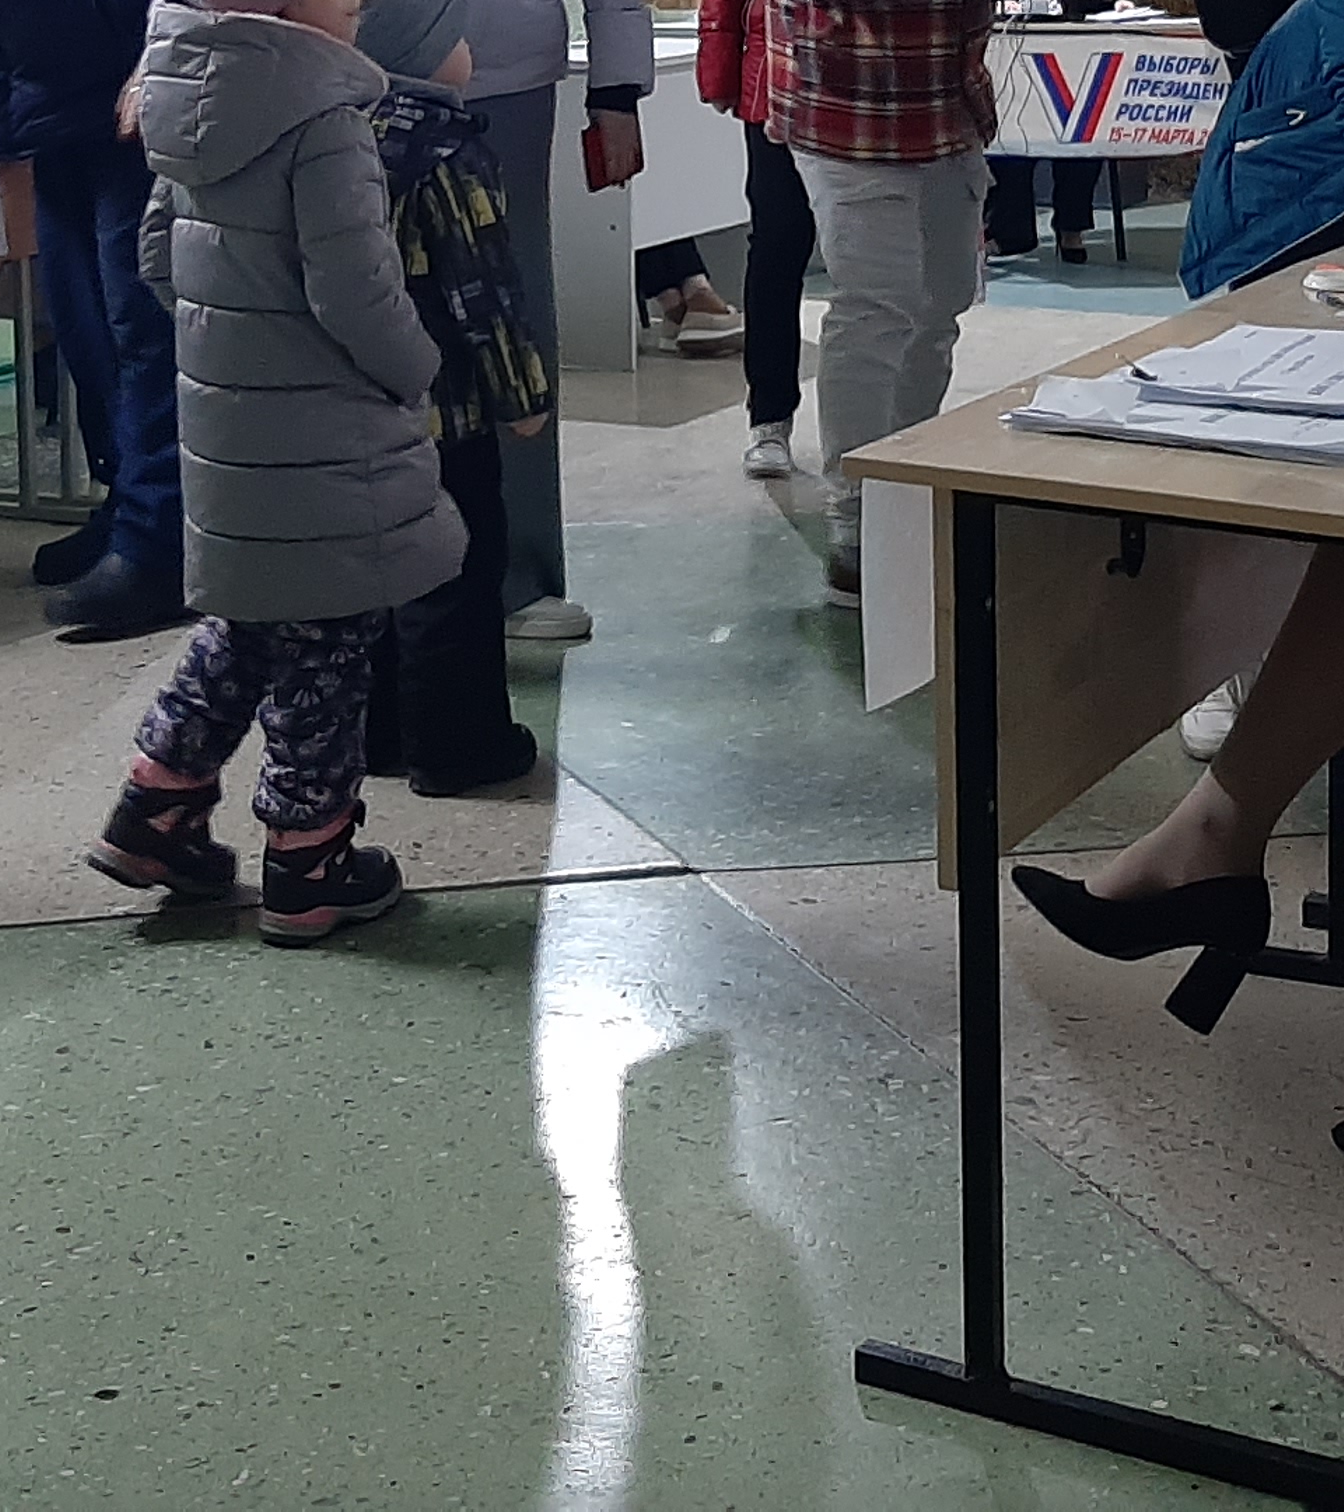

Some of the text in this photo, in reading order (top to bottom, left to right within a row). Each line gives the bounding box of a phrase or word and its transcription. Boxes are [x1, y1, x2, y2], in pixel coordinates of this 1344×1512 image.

[1134, 54, 1221, 76] ВЫБОРЫ
[1124, 79, 1232, 101] ПРЕЗИДЕН
[1115, 103, 1194, 122] РОССИИ
[1147, 128, 1195, 146] МАРТА
